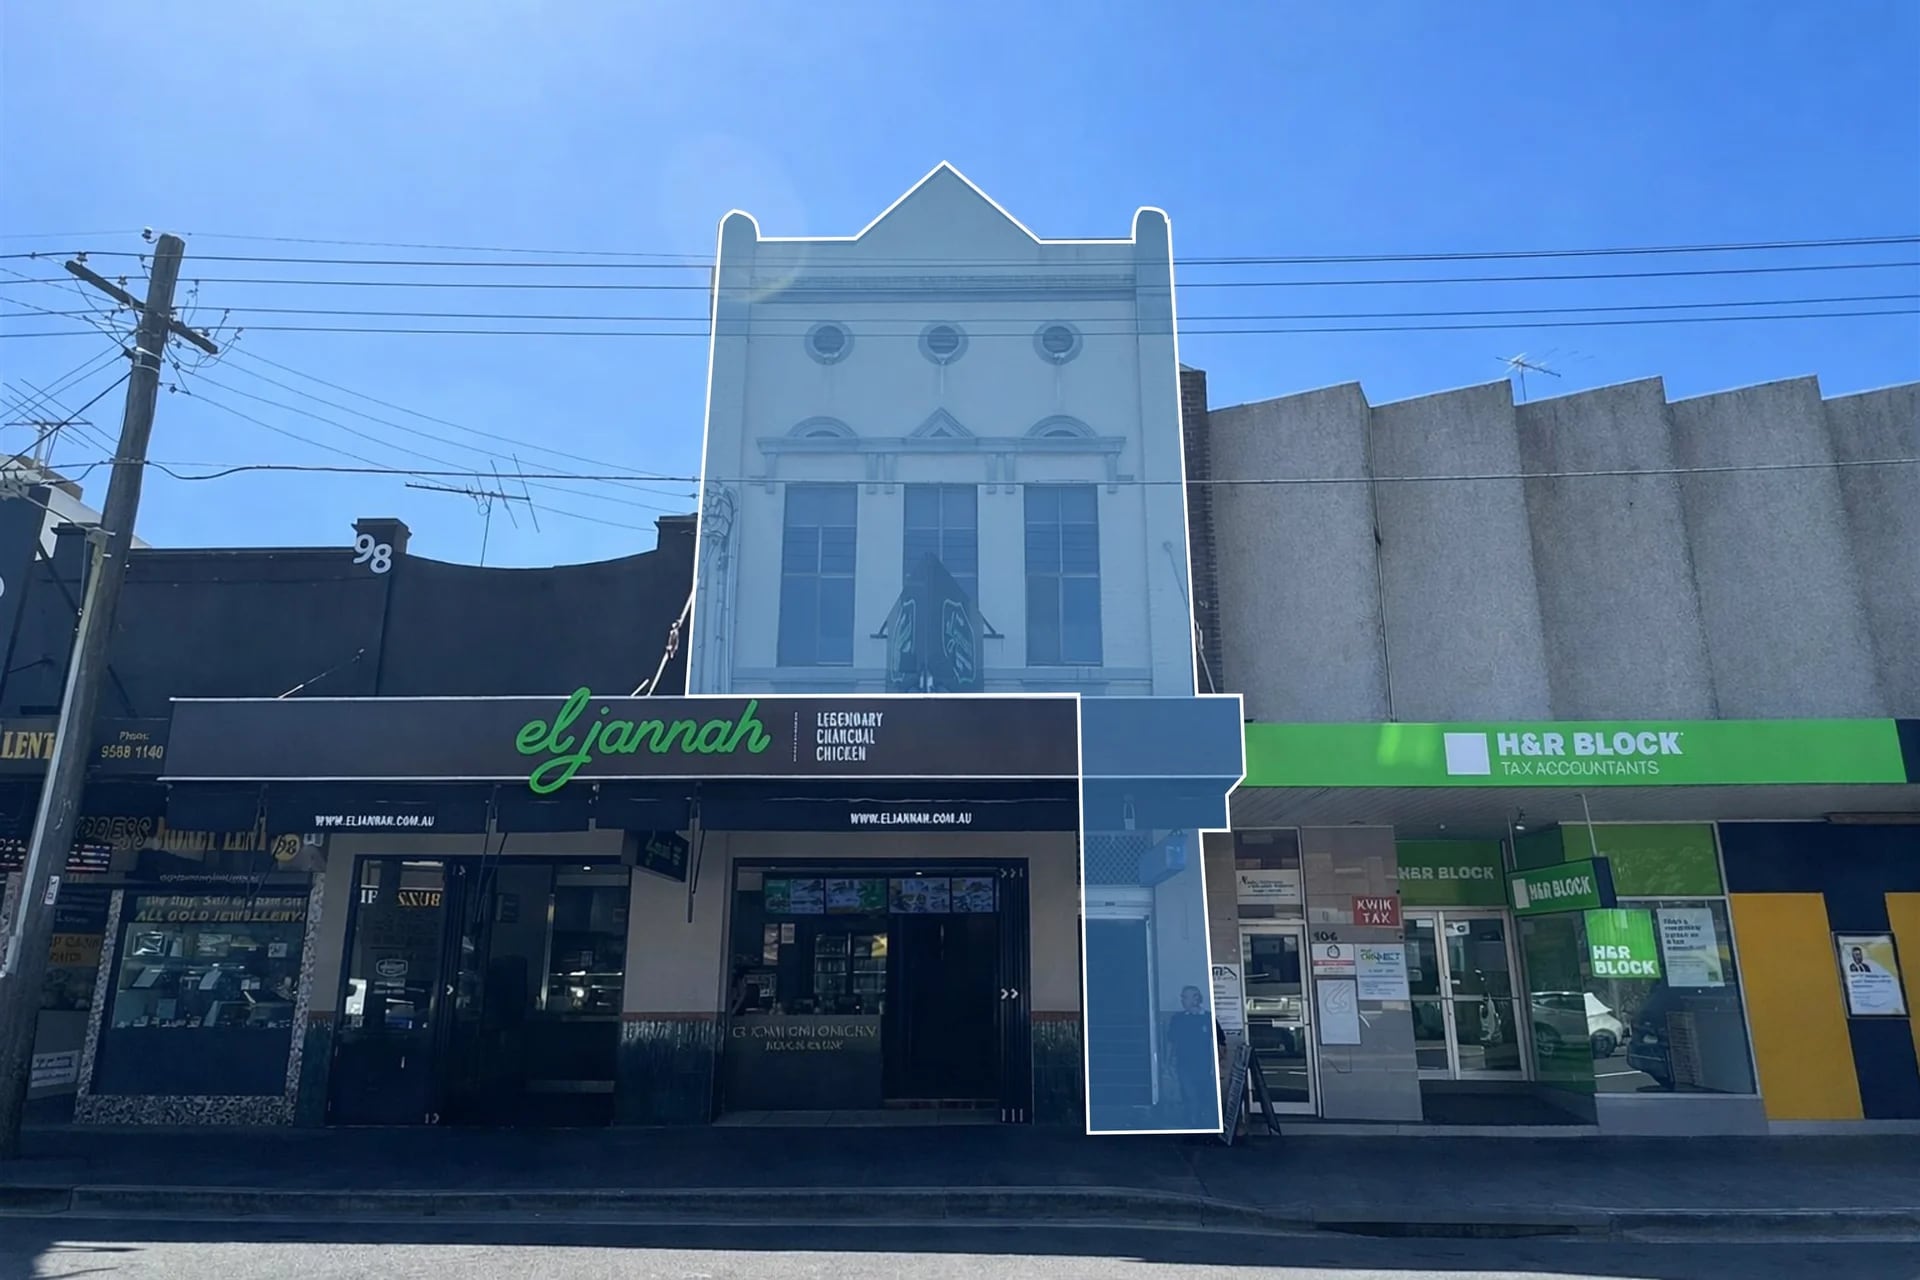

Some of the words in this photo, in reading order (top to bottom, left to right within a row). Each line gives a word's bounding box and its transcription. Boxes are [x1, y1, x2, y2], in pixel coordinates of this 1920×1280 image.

[353, 533, 392, 574] 98
[516, 687, 591, 754] el
[817, 712, 883, 727] LEGENDARY
[816, 728, 875, 744] CHARCOAL
[529, 699, 771, 794] jannah
[1497, 732, 1566, 756] H&R
[1573, 732, 1683, 756] BLOCK
[816, 746, 866, 761] CHICKEN
[1501, 761, 1532, 775] TAX
[1537, 760, 1660, 775] ACCOUNTANTS
[1438, 866, 1494, 880] BLOCK
[1552, 876, 1592, 898] BLOCK
[1357, 899, 1392, 911] KWIK
[1363, 911, 1391, 924] TAX
[1595, 960, 1656, 975] BLOCK
